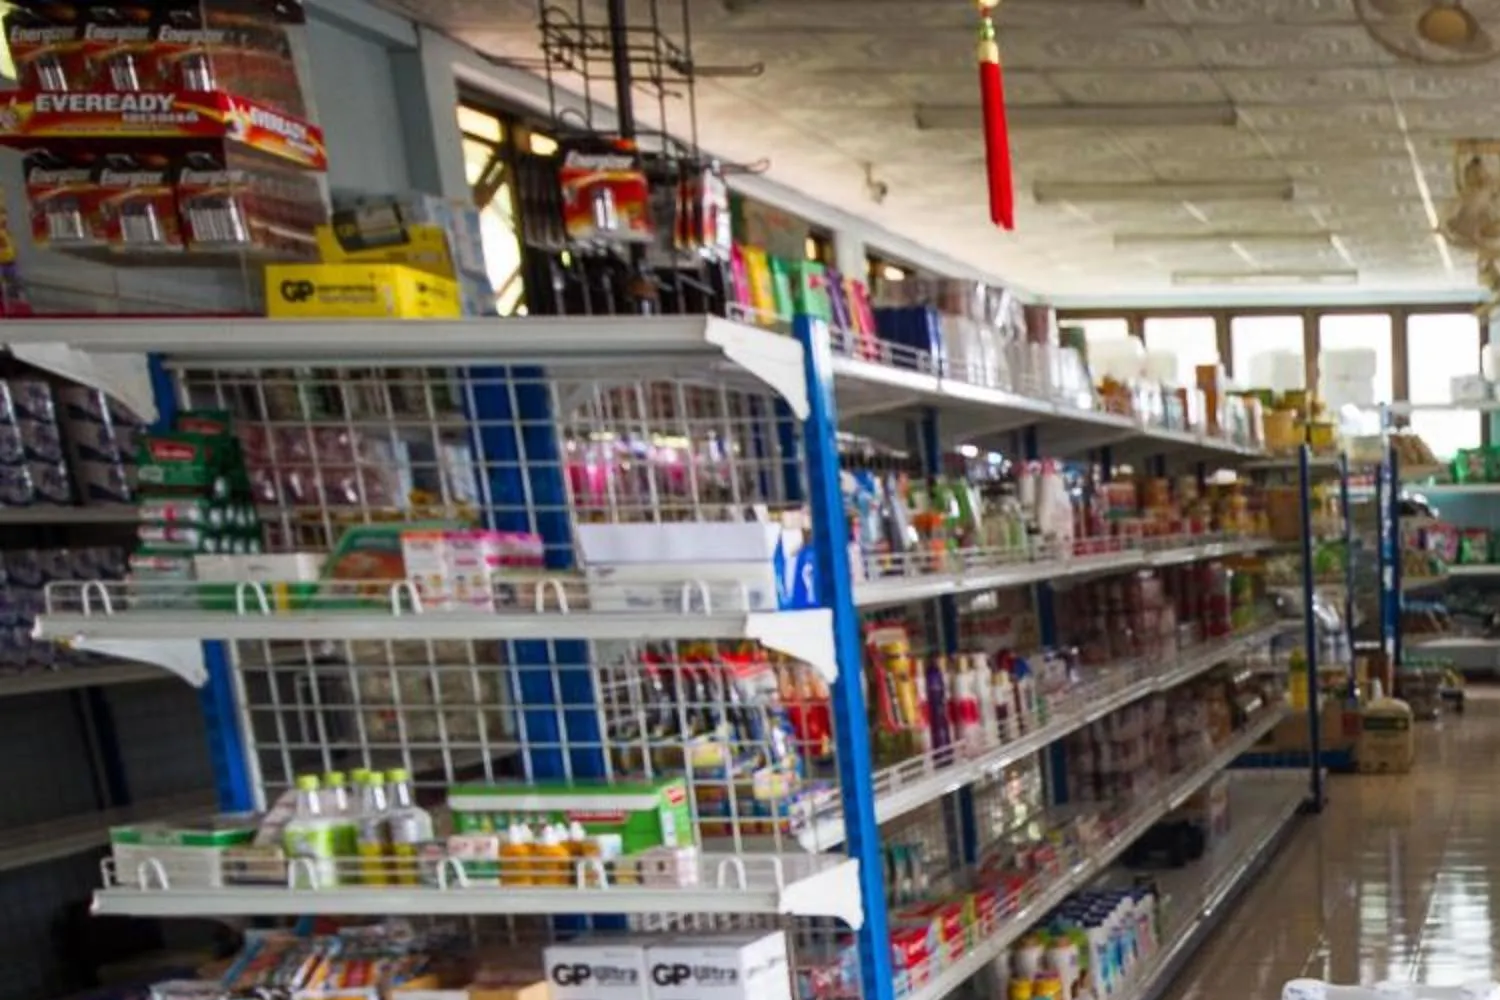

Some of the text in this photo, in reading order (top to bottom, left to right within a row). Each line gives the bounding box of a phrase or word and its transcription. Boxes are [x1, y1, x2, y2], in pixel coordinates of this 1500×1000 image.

[35, 93, 175, 113] EVEREADY
[553, 963, 591, 986] GP
[652, 963, 691, 986] GP
